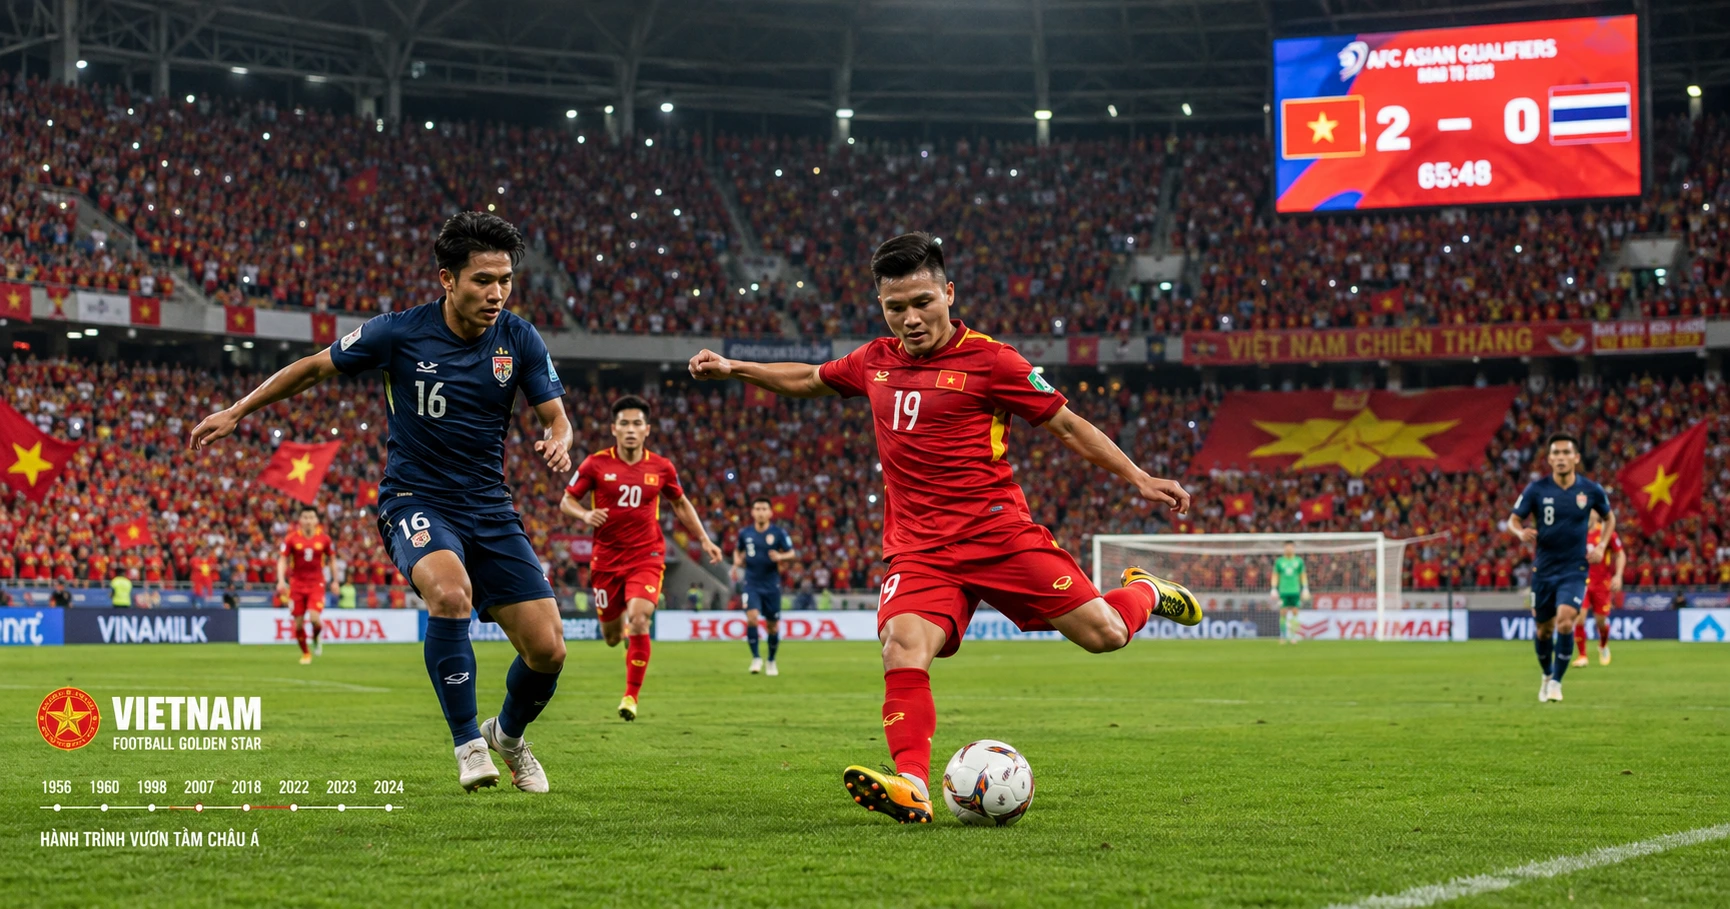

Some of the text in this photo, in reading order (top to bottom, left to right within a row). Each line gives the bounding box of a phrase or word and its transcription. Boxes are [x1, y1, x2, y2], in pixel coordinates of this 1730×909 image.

[1366, 38, 1558, 69] AFC ASIAN QUALIFIERS
[1376, 105, 1411, 152] 2
[1504, 97, 1540, 144] 0
[1417, 160, 1492, 189] 65:48
[1290, 332, 1348, 358] NAM
[414, 380, 447, 418] 16
[892, 390, 922, 431] 19
[617, 484, 642, 508] 20
[398, 511, 431, 541] 16
[1543, 505, 1555, 526] 8
[97, 615, 208, 643] VINAMILK
[274, 617, 387, 640] HNDA
